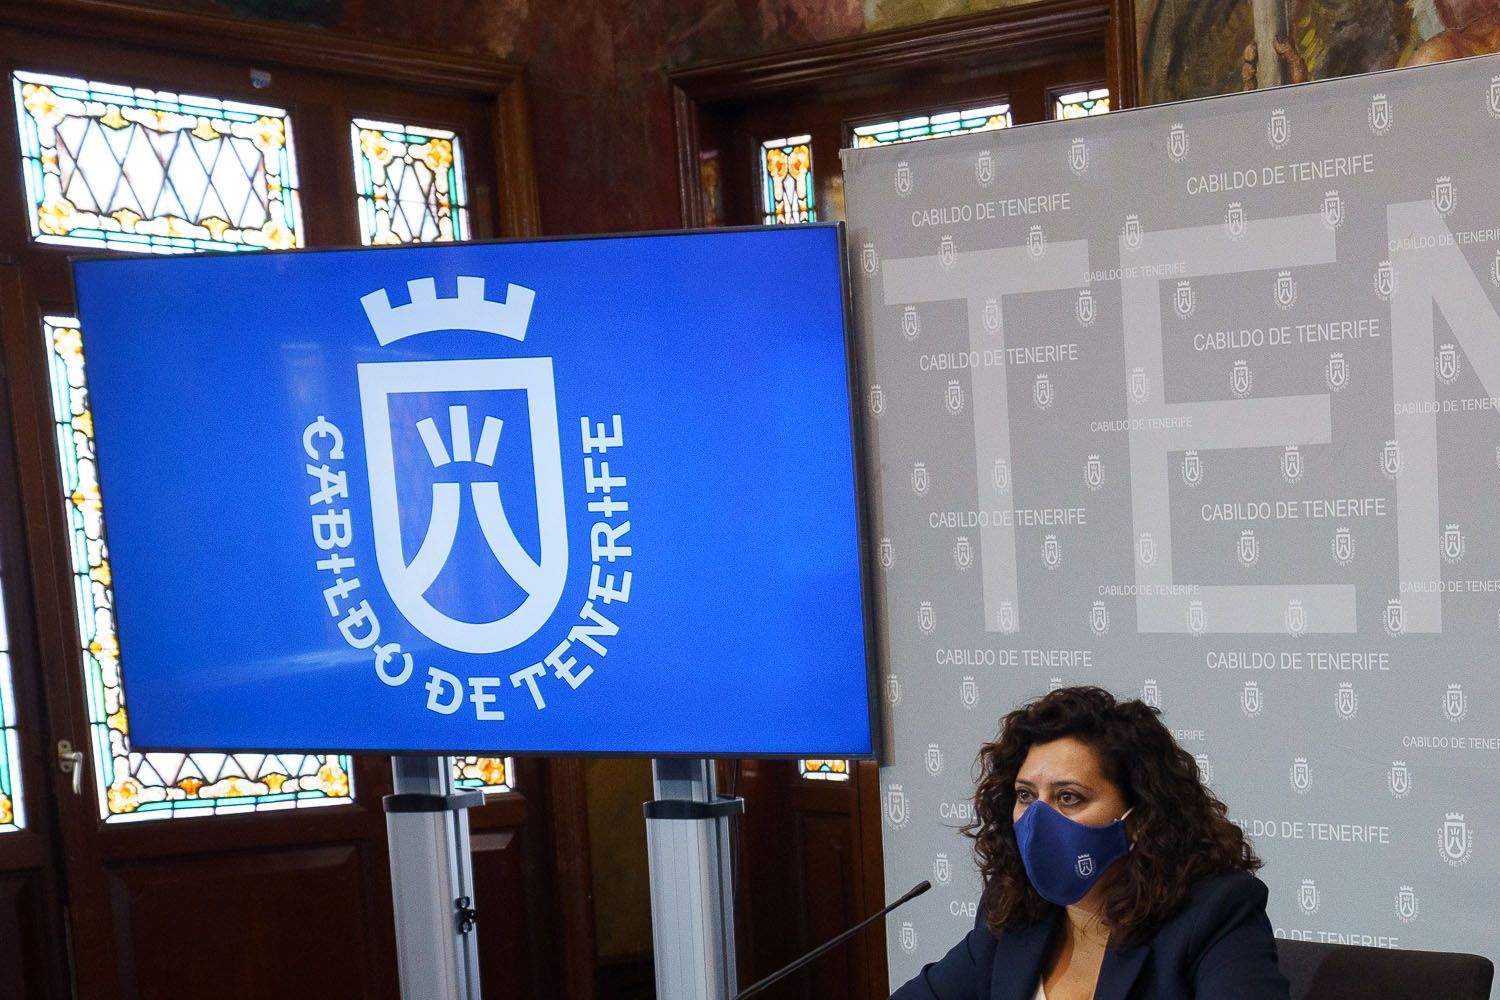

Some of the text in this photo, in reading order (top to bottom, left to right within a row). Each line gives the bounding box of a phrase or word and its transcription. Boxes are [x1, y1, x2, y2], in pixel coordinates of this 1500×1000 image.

[1186, 154, 1373, 195] CABILDO DE TENERIFE
[911, 193, 1070, 228] CABILDO DE TENERIFE
[1388, 234, 1436, 252] CABILDO
[1437, 233, 1453, 247] DE
[1082, 262, 1186, 282] CABILDO DE TENERIFE
[1192, 319, 1379, 352] CABILDO DE TENERIFE
[919, 344, 1078, 371] CABILDO DE TENERIFE
[1393, 400, 1441, 415] CABILDO
[1441, 399, 1458, 412] DE
[1088, 416, 1192, 433] CABILDO DE TENERIFE
[928, 507, 1086, 529] CABILDO DE TENERIFE
[1200, 498, 1386, 522] CABILDO DE TENERIFE
[301, 414, 633, 721] CABILDO DE TENERIFE
[1097, 584, 1200, 596] CABILDO DE TENERIFE
[1399, 580, 1446, 593] CABILDO
[1447, 580, 1463, 592] DE
[935, 648, 1092, 668] CABILDO DE TENERIFE
[1205, 651, 1389, 671] CABILDO DE TENERIFE
[1402, 735, 1449, 749] CABILDO
[1450, 736, 1466, 749] DE
[940, 802, 972, 819] CABI
[1281, 821, 1304, 839] DE
[1308, 822, 1390, 844] TENERIFE
